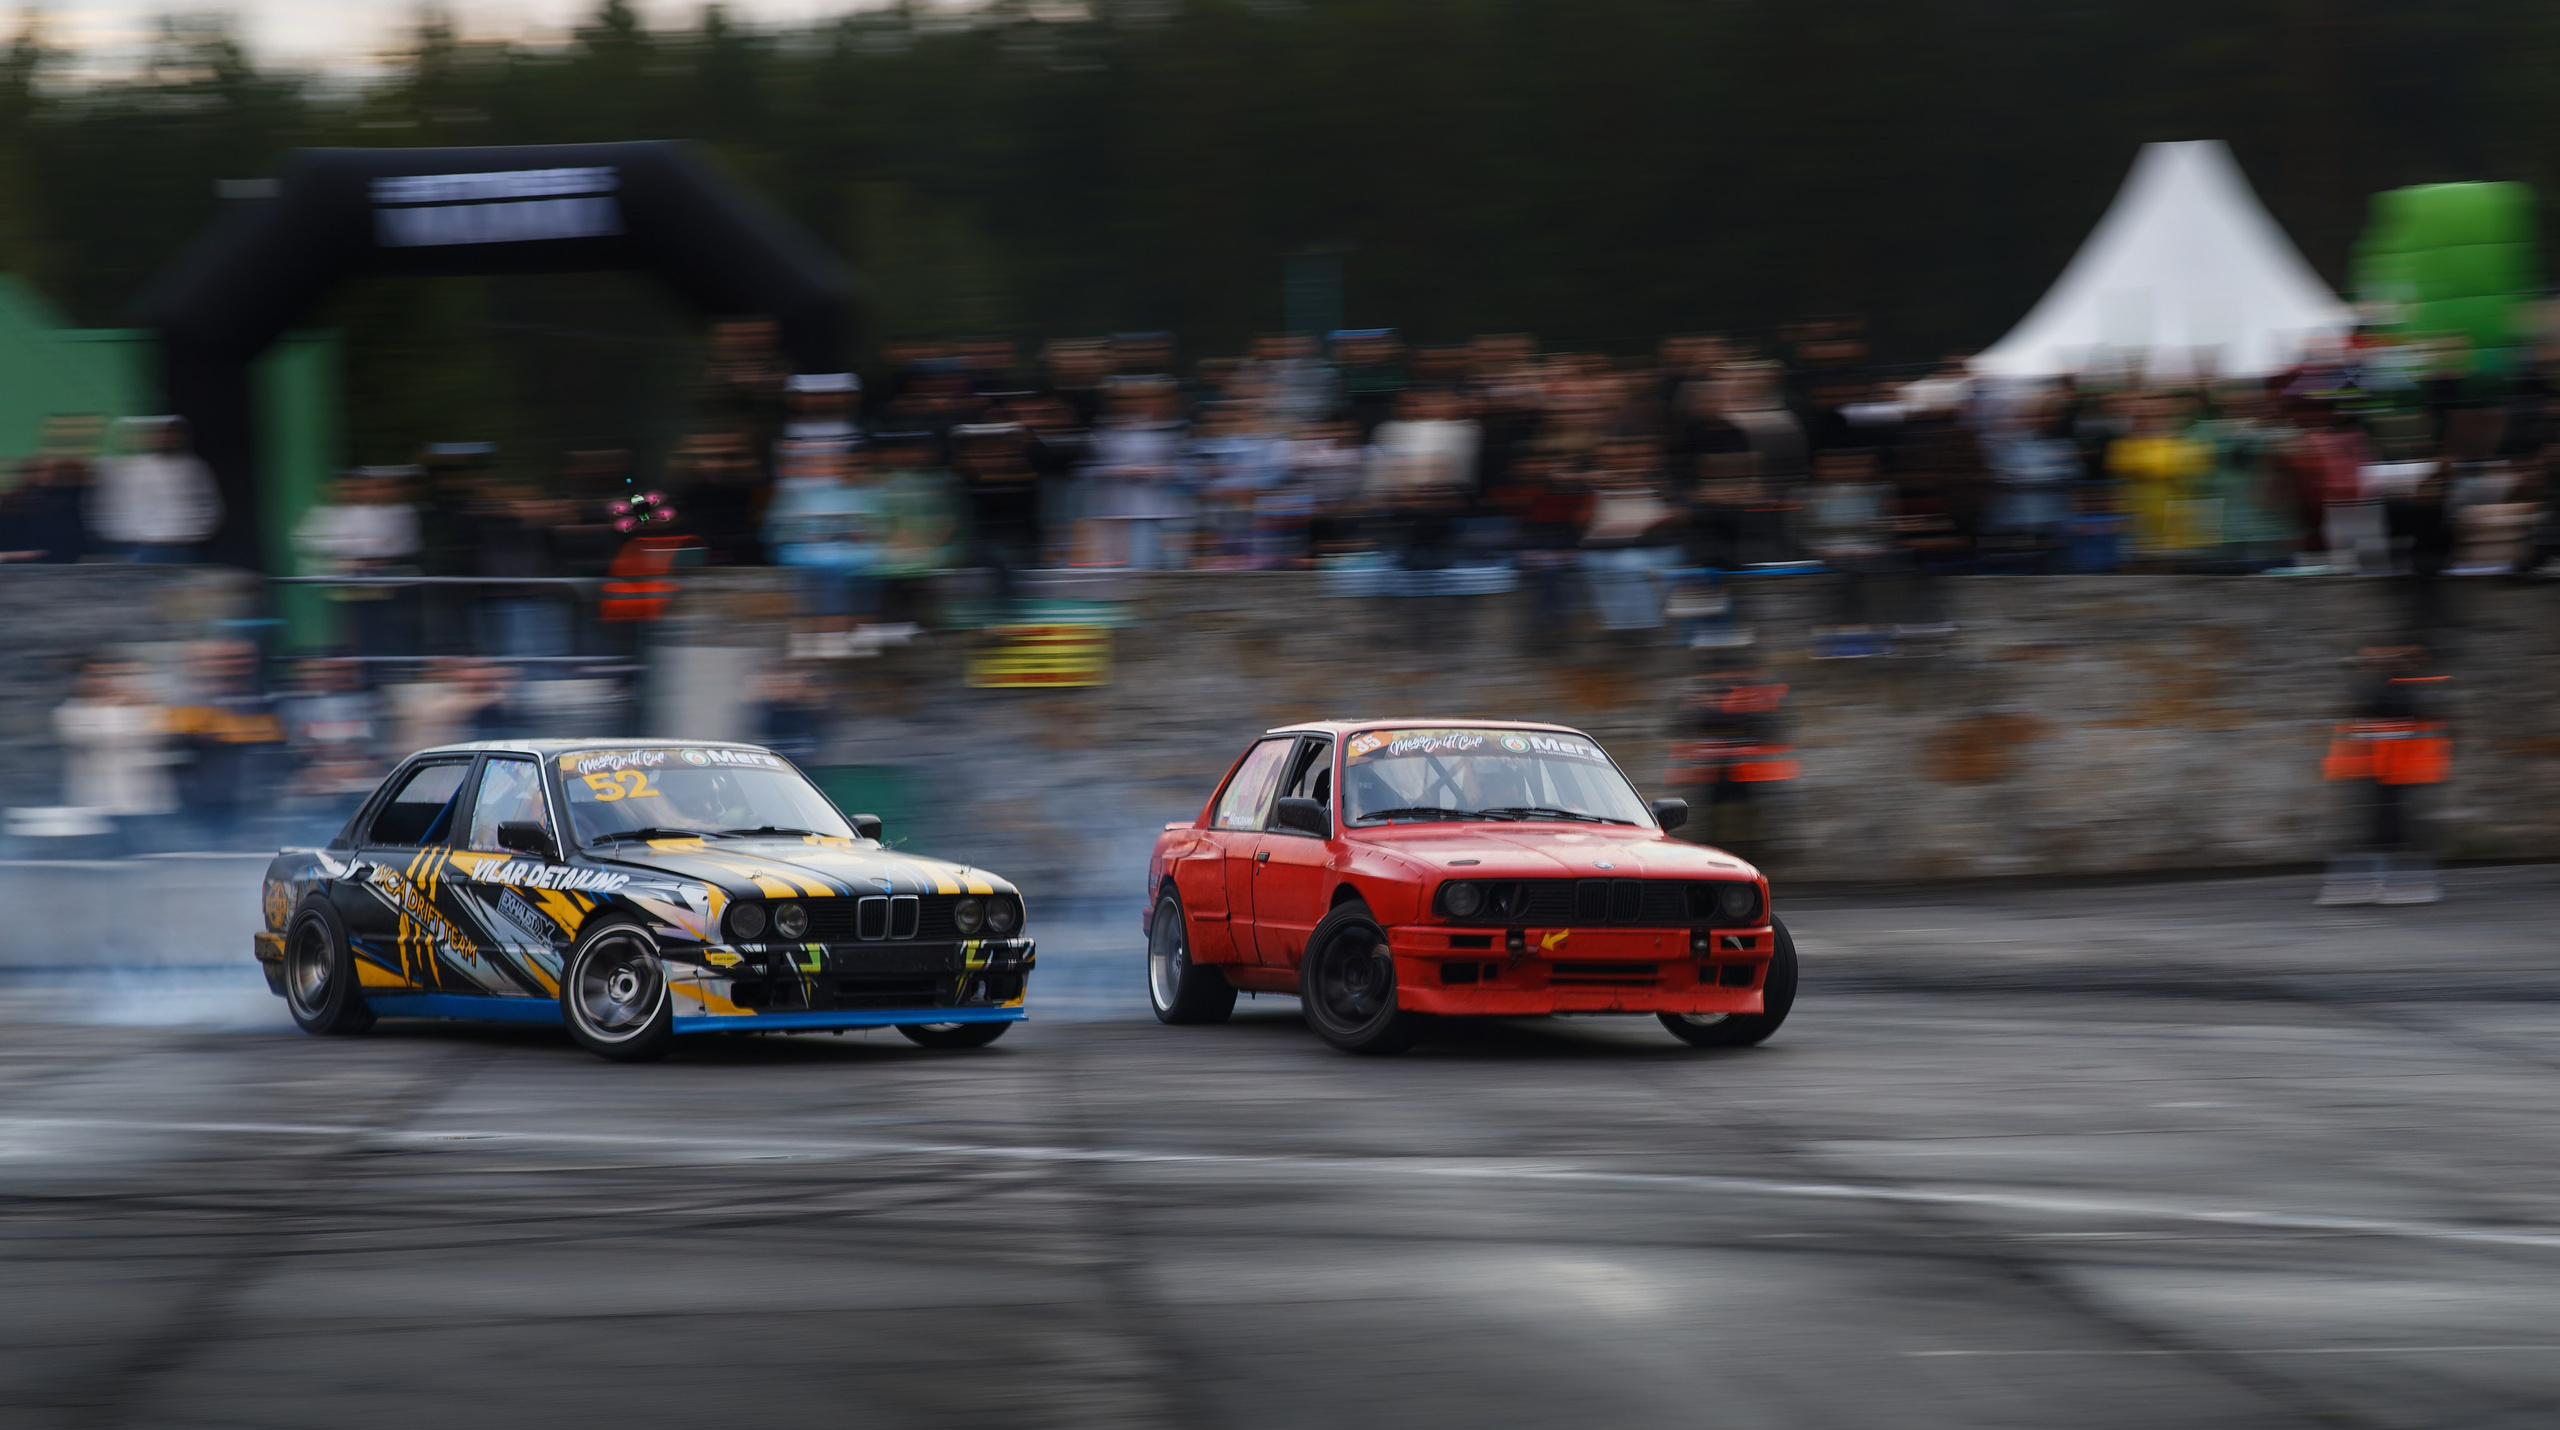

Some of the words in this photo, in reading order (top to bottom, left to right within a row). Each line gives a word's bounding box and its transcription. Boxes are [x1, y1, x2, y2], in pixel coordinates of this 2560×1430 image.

[1351, 735, 1382, 753] 35
[1389, 736, 1424, 756] Mega
[1421, 732, 1459, 753] Drift
[1459, 734, 1483, 751] Cup
[577, 754, 612, 775] Mega
[609, 748, 643, 771] Drift
[642, 751, 665, 767] Cup
[582, 769, 660, 802] 52
[471, 858, 529, 886] VILAR
[524, 864, 630, 892] DETAILING
[407, 886, 444, 933] DRIFT
[443, 917, 478, 968] TEAM
[501, 891, 538, 930] EXHAUST
